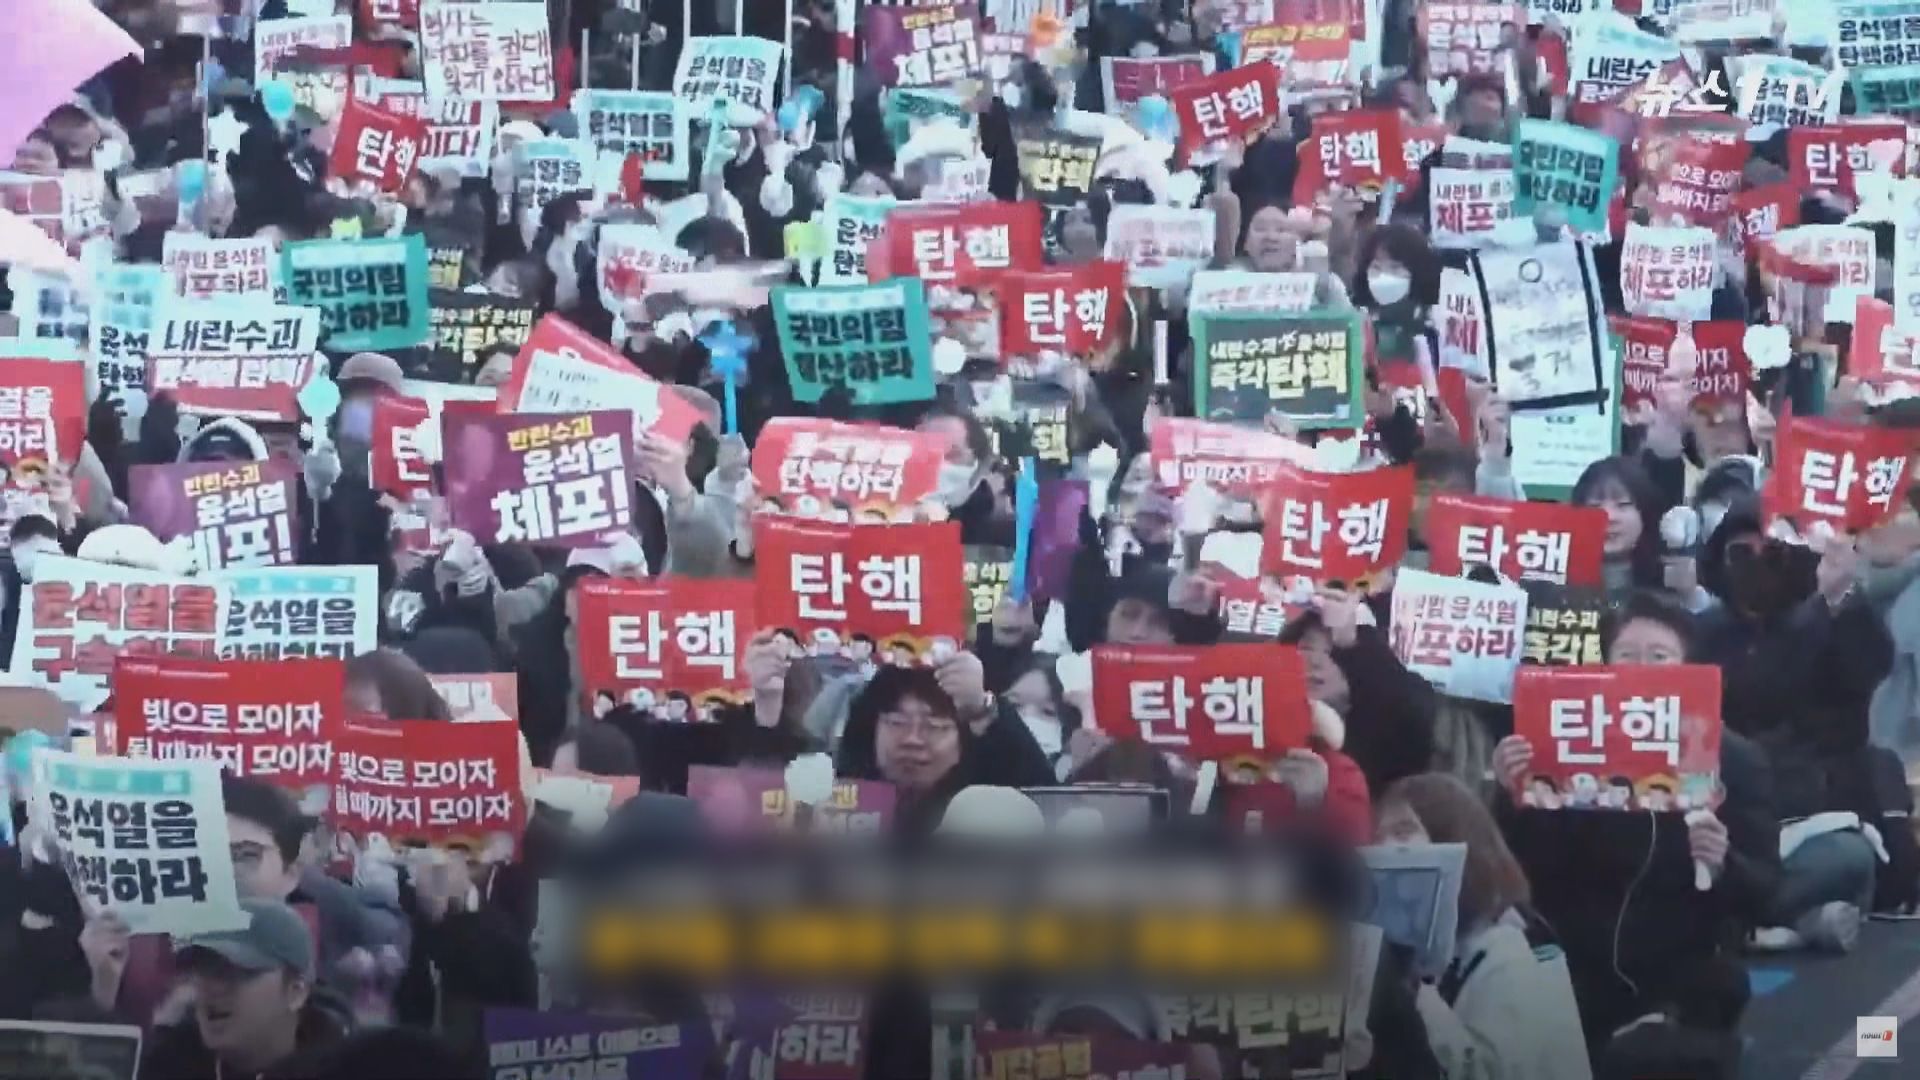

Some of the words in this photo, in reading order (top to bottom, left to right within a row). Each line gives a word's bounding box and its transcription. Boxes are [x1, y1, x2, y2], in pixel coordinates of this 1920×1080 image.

[1194, 79, 1264, 137] 탄핵
[1320, 129, 1380, 178] 탄핵
[837, 217, 885, 247] 윤석
[912, 223, 1010, 280] 탄핵
[291, 265, 408, 298] 국민의힘
[164, 318, 302, 352] 내란수괴
[788, 307, 908, 347] 국민의힘
[1023, 286, 1109, 343] 탄핵
[1624, 340, 1665, 369] 으로
[507, 415, 594, 452] 반란수괴
[523, 433, 625, 484] 윤석열
[1801, 449, 1906, 515] 탄핵
[197, 480, 287, 527] 윤석열
[491, 468, 631, 544] 체포!
[1281, 498, 1390, 568] 탄핵
[1458, 525, 1572, 585] 탄핵
[790, 553, 922, 625] 탄핵
[1451, 595, 1518, 625] 윤석열
[226, 598, 357, 636] 윤석열을
[608, 609, 736, 681] 탄핵
[142, 698, 230, 735] 빛으로
[234, 701, 324, 737] 모이자
[1129, 675, 1265, 750] 탄핵
[1550, 694, 1681, 767] 탄핵
[250, 741, 335, 777] 모이자
[338, 750, 406, 788] 빛으로
[412, 758, 497, 790] 모이자
[48, 791, 199, 850] 윤석열을
[427, 794, 513, 827] 모이자
[72, 854, 208, 905] 핵하라
[780, 1023, 861, 1067] 하라
